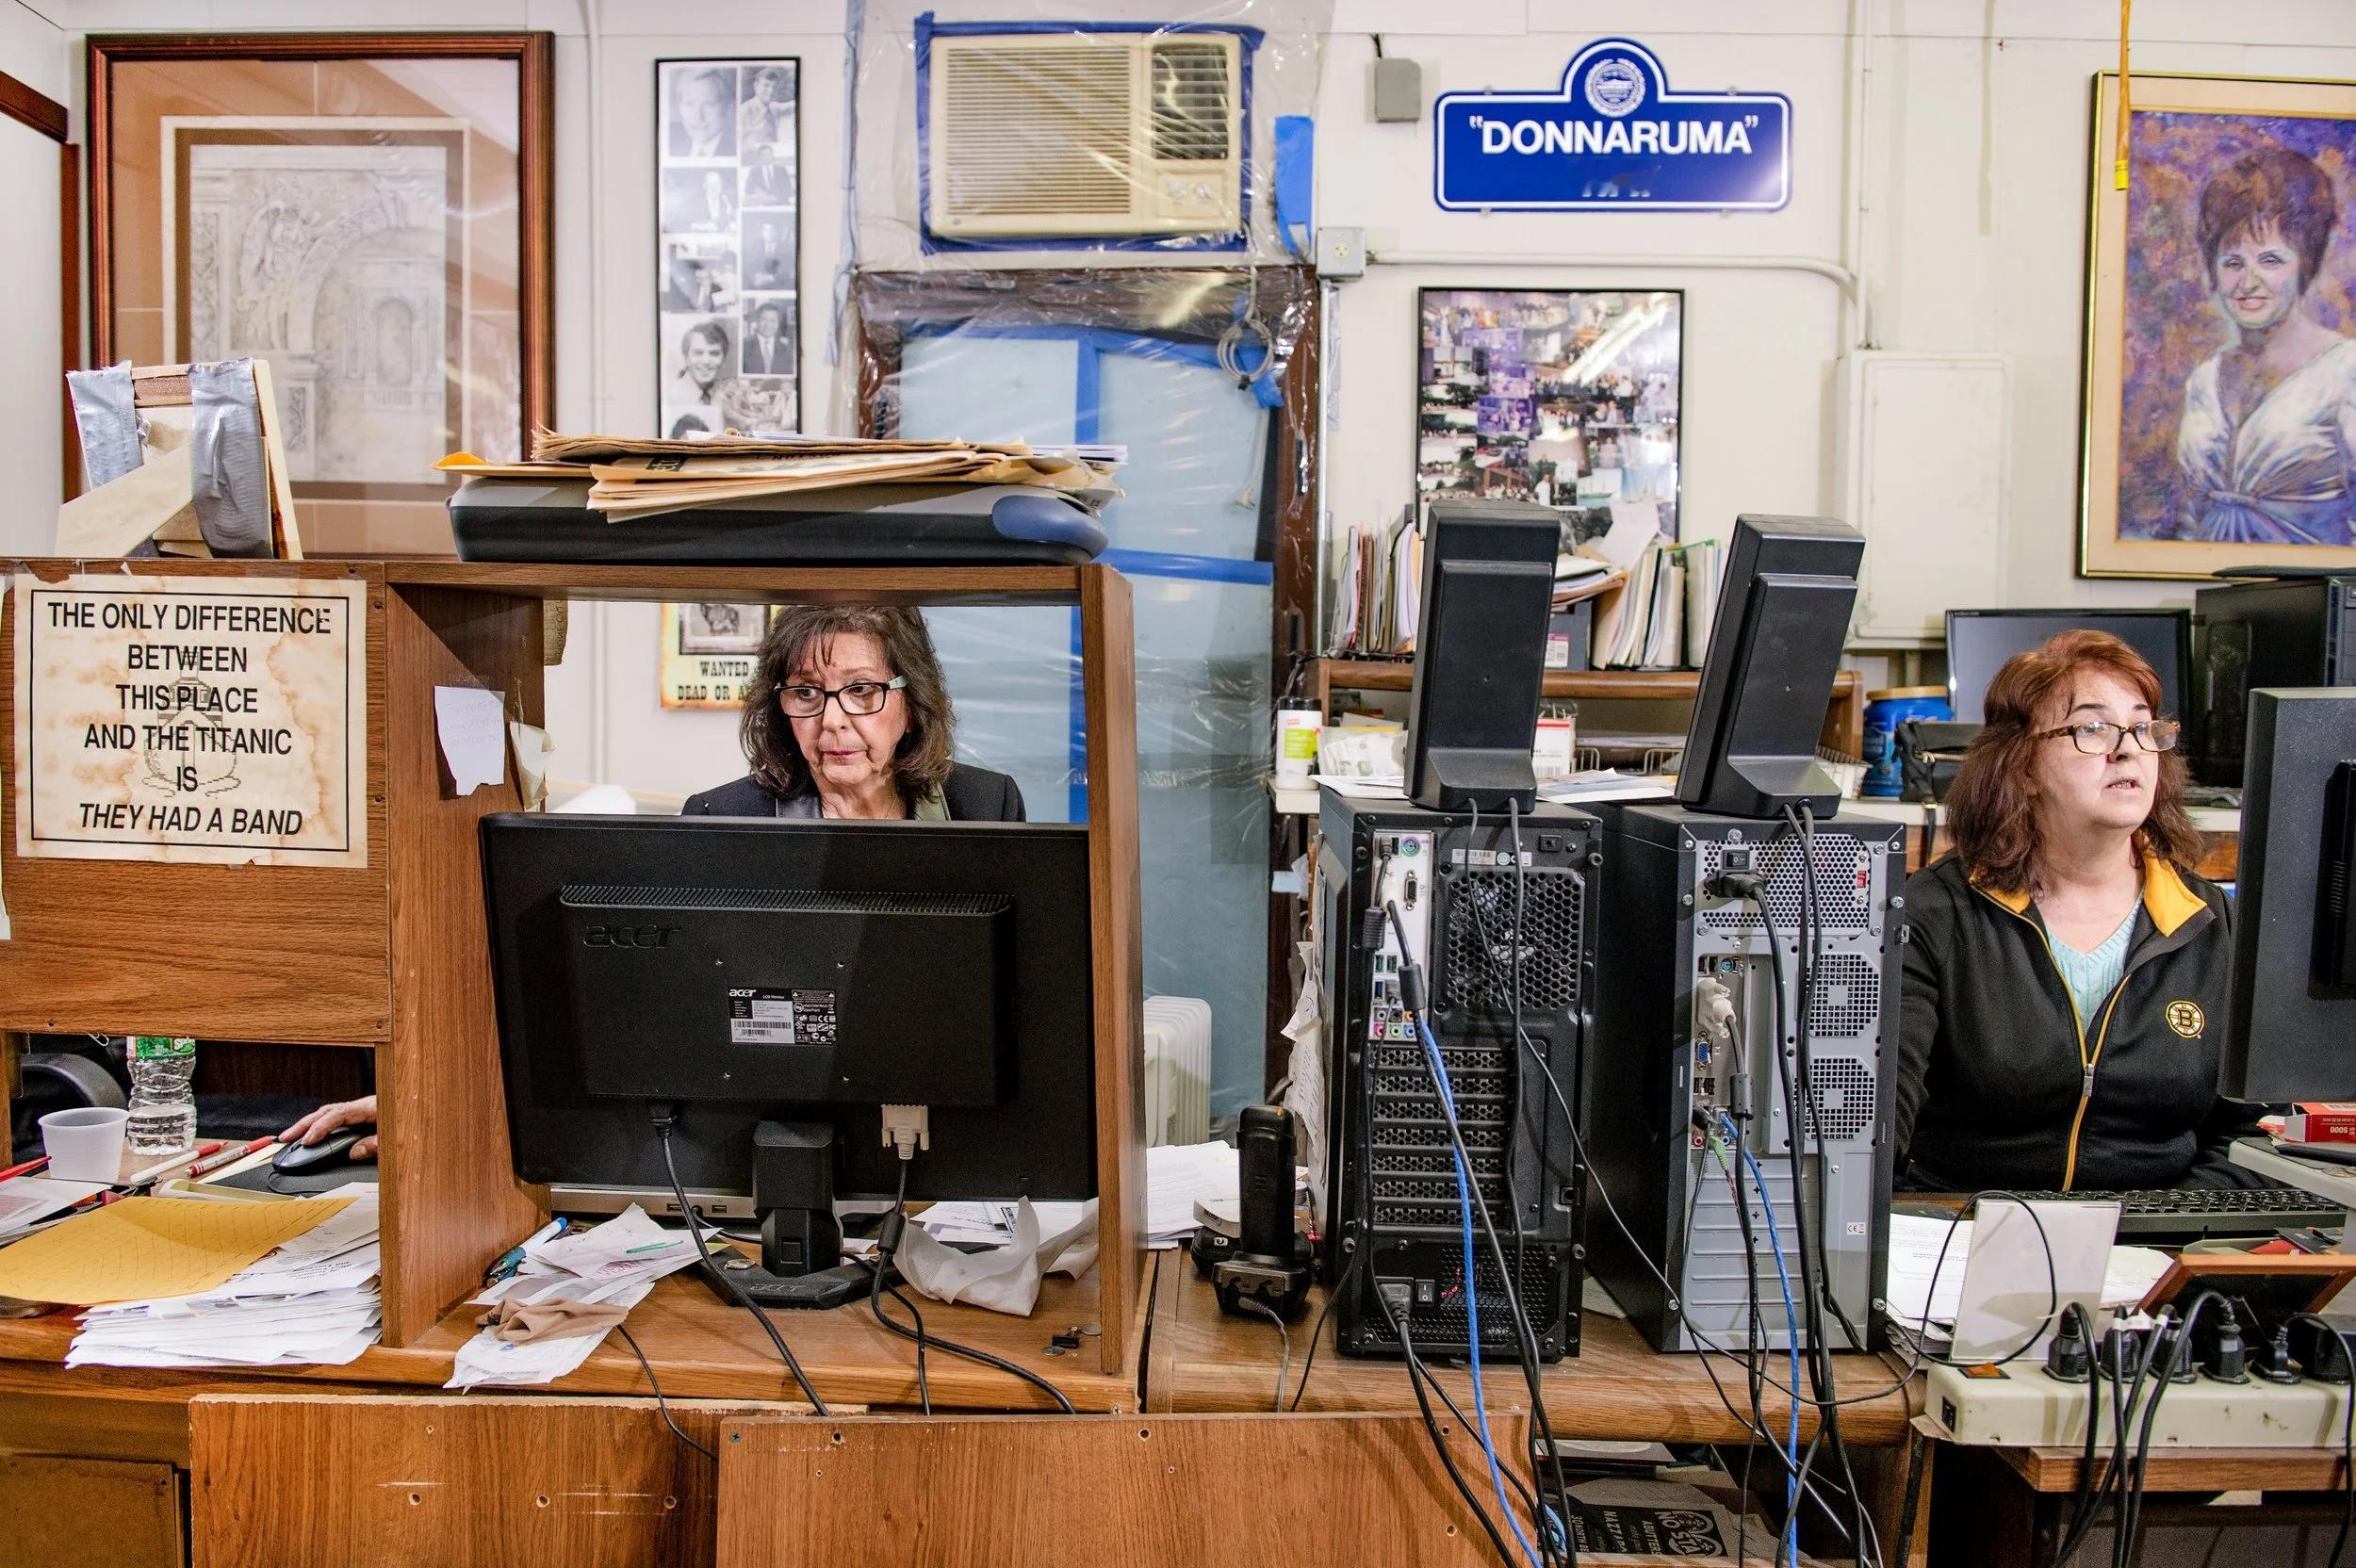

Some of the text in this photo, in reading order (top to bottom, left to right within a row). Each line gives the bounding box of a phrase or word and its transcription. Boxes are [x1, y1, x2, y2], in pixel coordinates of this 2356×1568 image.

[47, 602, 332, 635] THE ONLY DIFFERENCE
[127, 644, 248, 673] BETWEEN
[700, 662, 749, 677] WANTED
[115, 684, 259, 714] THIS PLACE
[678, 685, 708, 701] DEAD
[714, 685, 730, 701] OR
[84, 724, 293, 755] AND THE TITANIC
[176, 765, 198, 792] IS
[79, 803, 303, 837] THEY HAD A BAND
[583, 924, 681, 948] acer
[728, 988, 758, 998] acer
[1655, 1511, 1681, 1528] NO
